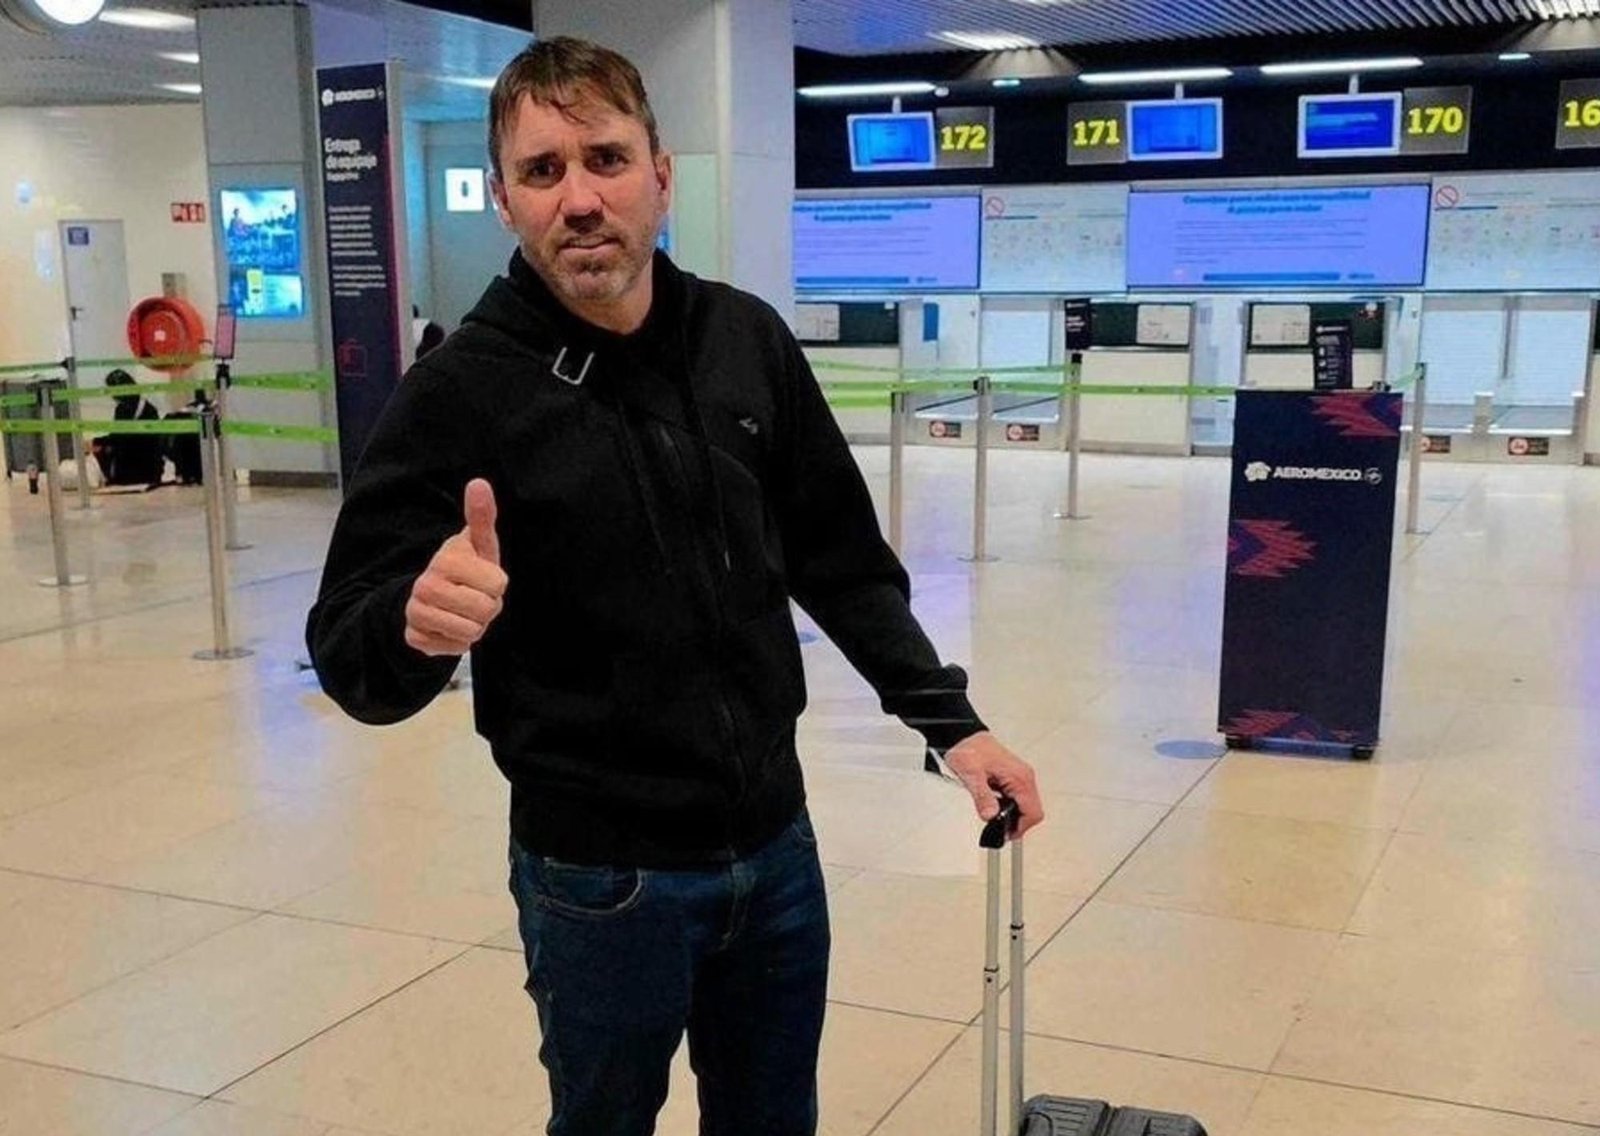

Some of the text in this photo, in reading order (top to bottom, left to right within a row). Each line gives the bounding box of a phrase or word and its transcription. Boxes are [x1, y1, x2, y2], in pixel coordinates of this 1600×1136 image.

[1072, 119, 1121, 147] 171
[1407, 106, 1464, 134] 170
[940, 124, 987, 151] 172
[1273, 466, 1362, 481] AEROMEXICO
